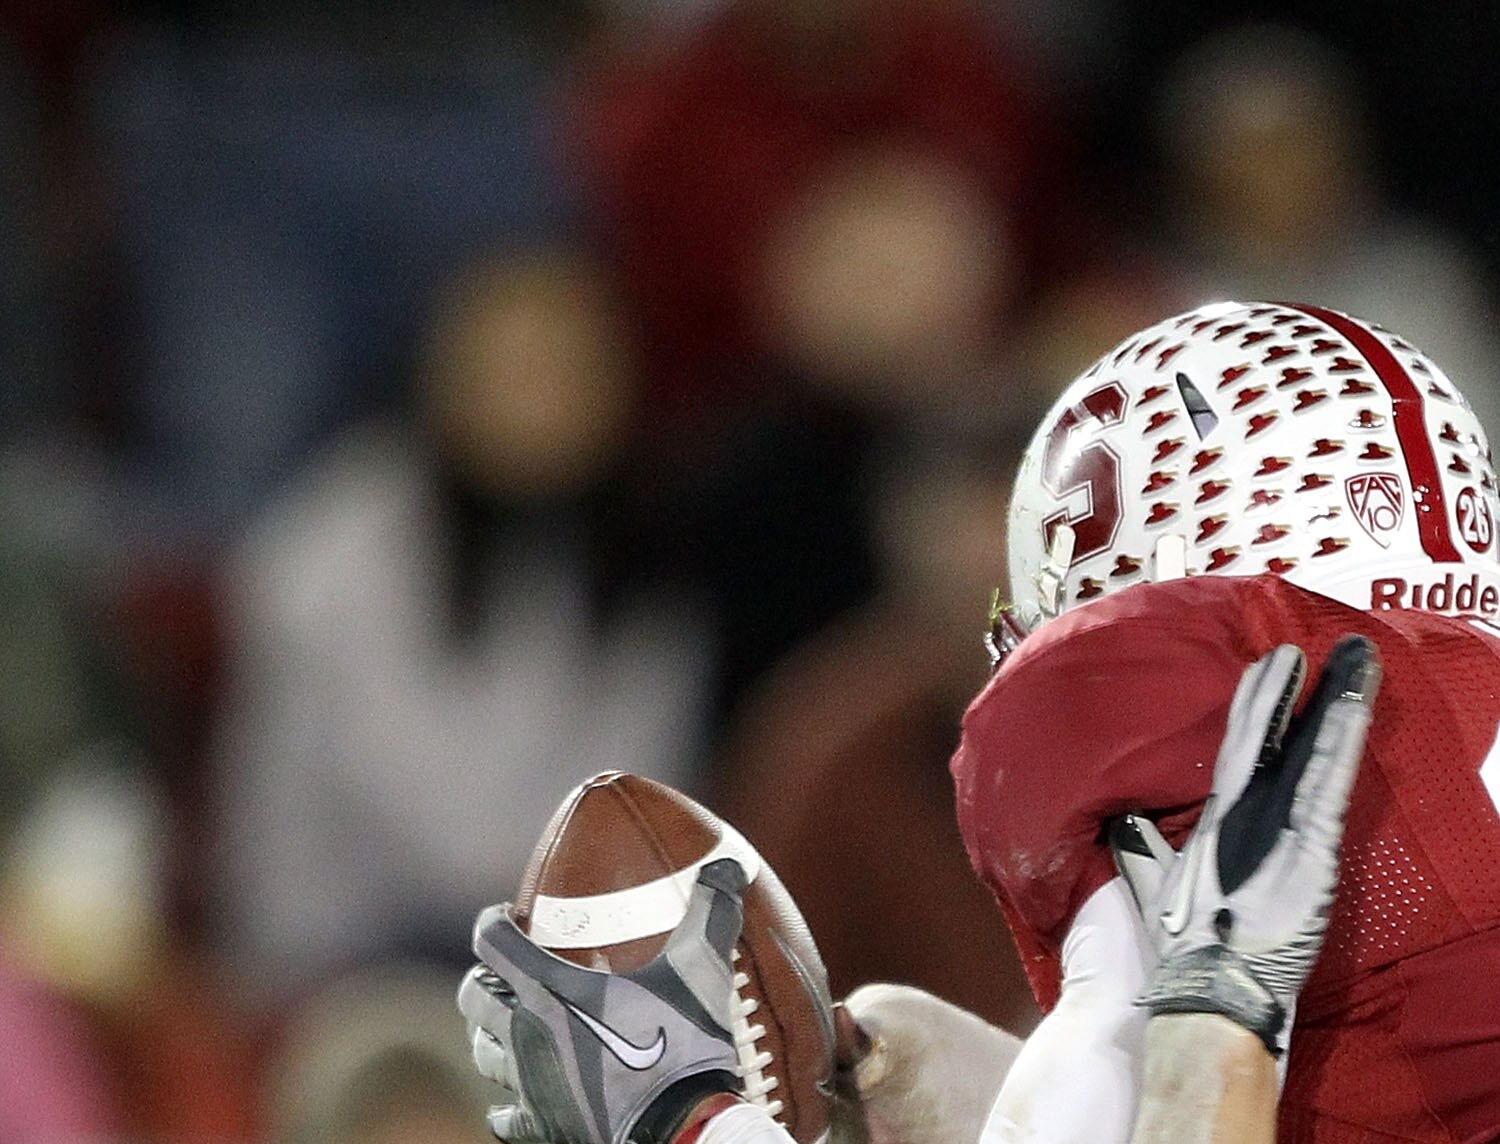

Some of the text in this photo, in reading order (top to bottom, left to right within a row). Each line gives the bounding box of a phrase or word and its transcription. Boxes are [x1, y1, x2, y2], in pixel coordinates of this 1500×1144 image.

[1041, 380, 1129, 567] S
[1348, 474, 1402, 520] PAC
[1366, 503, 1398, 533] 10
[1458, 489, 1491, 546] 26
